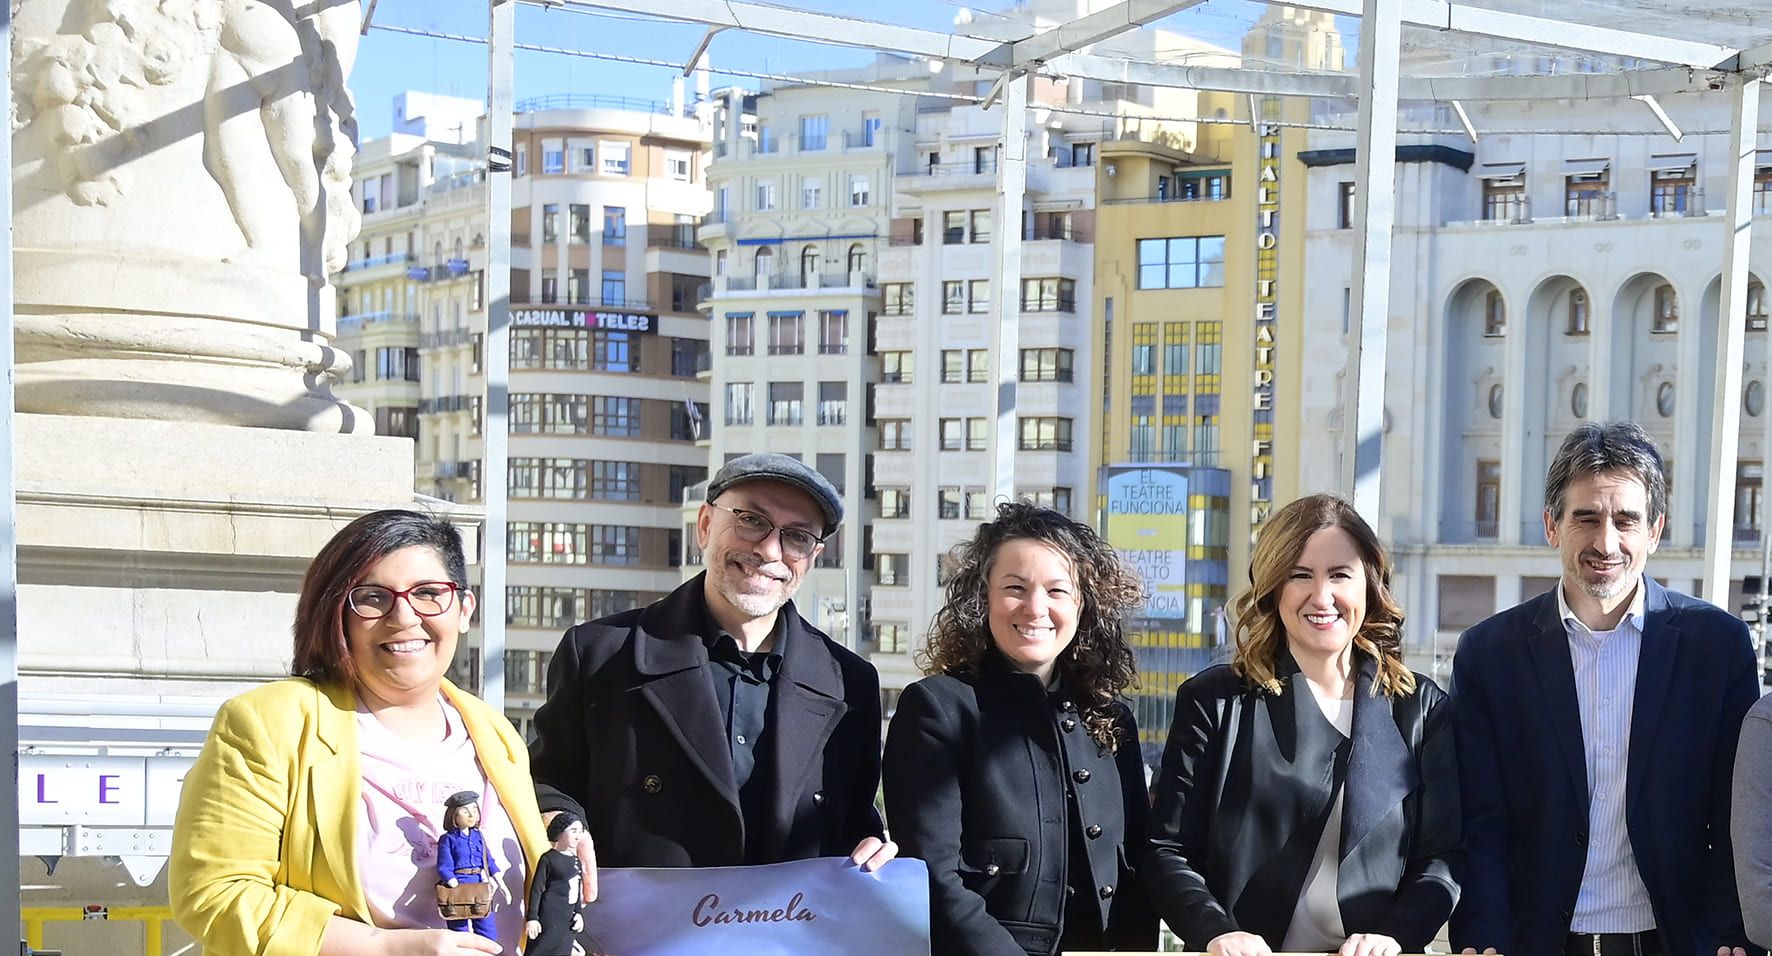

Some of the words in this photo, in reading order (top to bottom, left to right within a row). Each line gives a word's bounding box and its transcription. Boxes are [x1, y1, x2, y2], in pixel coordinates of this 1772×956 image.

[1258, 121, 1278, 249] RIALTO
[1254, 280, 1277, 410] TEATRE
[1140, 470, 1156, 484] EL
[1122, 485, 1174, 500] TEATRE
[1111, 500, 1185, 515] FUNCIONA
[1122, 551, 1172, 565] TEATRE
[692, 892, 817, 928] Carmela
